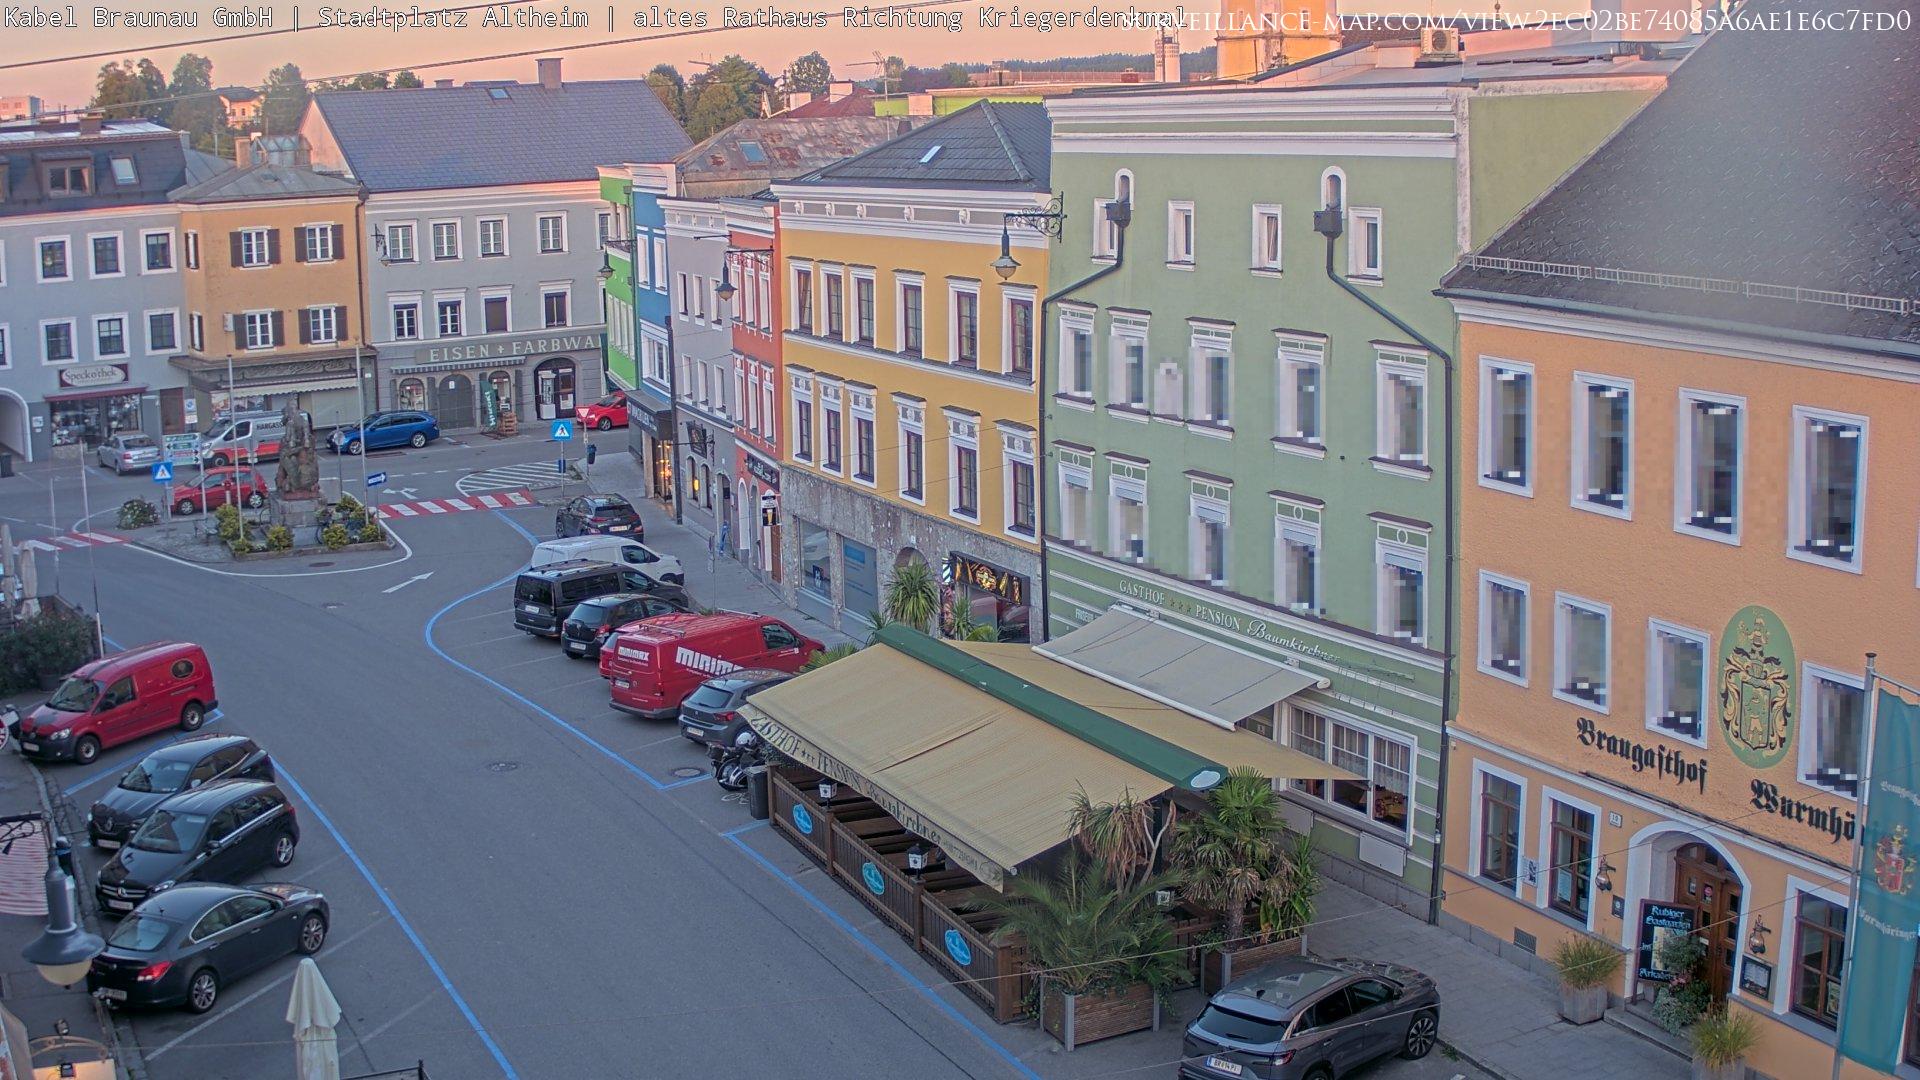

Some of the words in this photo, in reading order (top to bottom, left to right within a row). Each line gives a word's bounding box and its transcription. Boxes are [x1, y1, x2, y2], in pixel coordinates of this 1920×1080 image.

[429, 345, 489, 362] EISEN
[1119, 579, 1166, 605] GASTHOF
[1195, 604, 1241, 631] PENSION
[1247, 619, 1342, 663] Baumkirchner
[675, 646, 744, 677] minim
[1576, 717, 1708, 795] Braugasthof
[1750, 778, 1864, 845] Wurmhö
